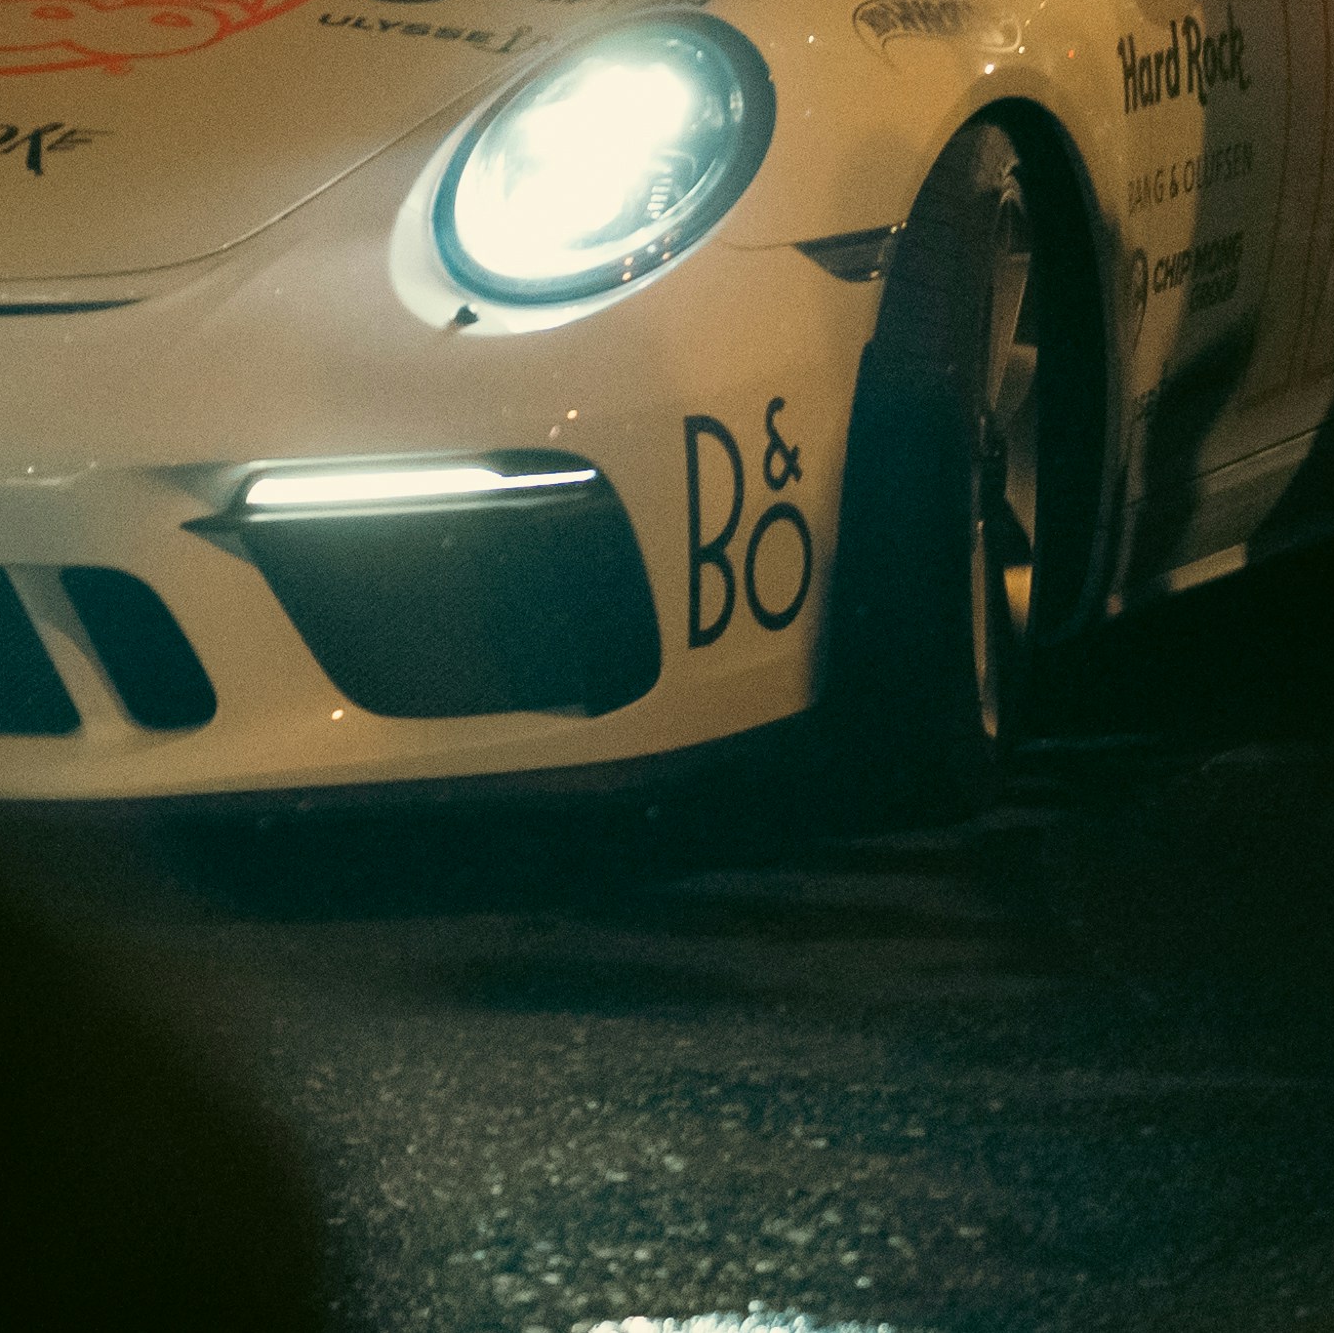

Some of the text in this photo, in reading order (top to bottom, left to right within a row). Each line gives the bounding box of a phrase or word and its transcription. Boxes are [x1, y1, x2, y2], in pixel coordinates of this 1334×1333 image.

[318, 12, 495, 45] ULYSSE
[1117, 4, 1251, 114] Hard Rock
[1153, 250, 1192, 293] CHIP
